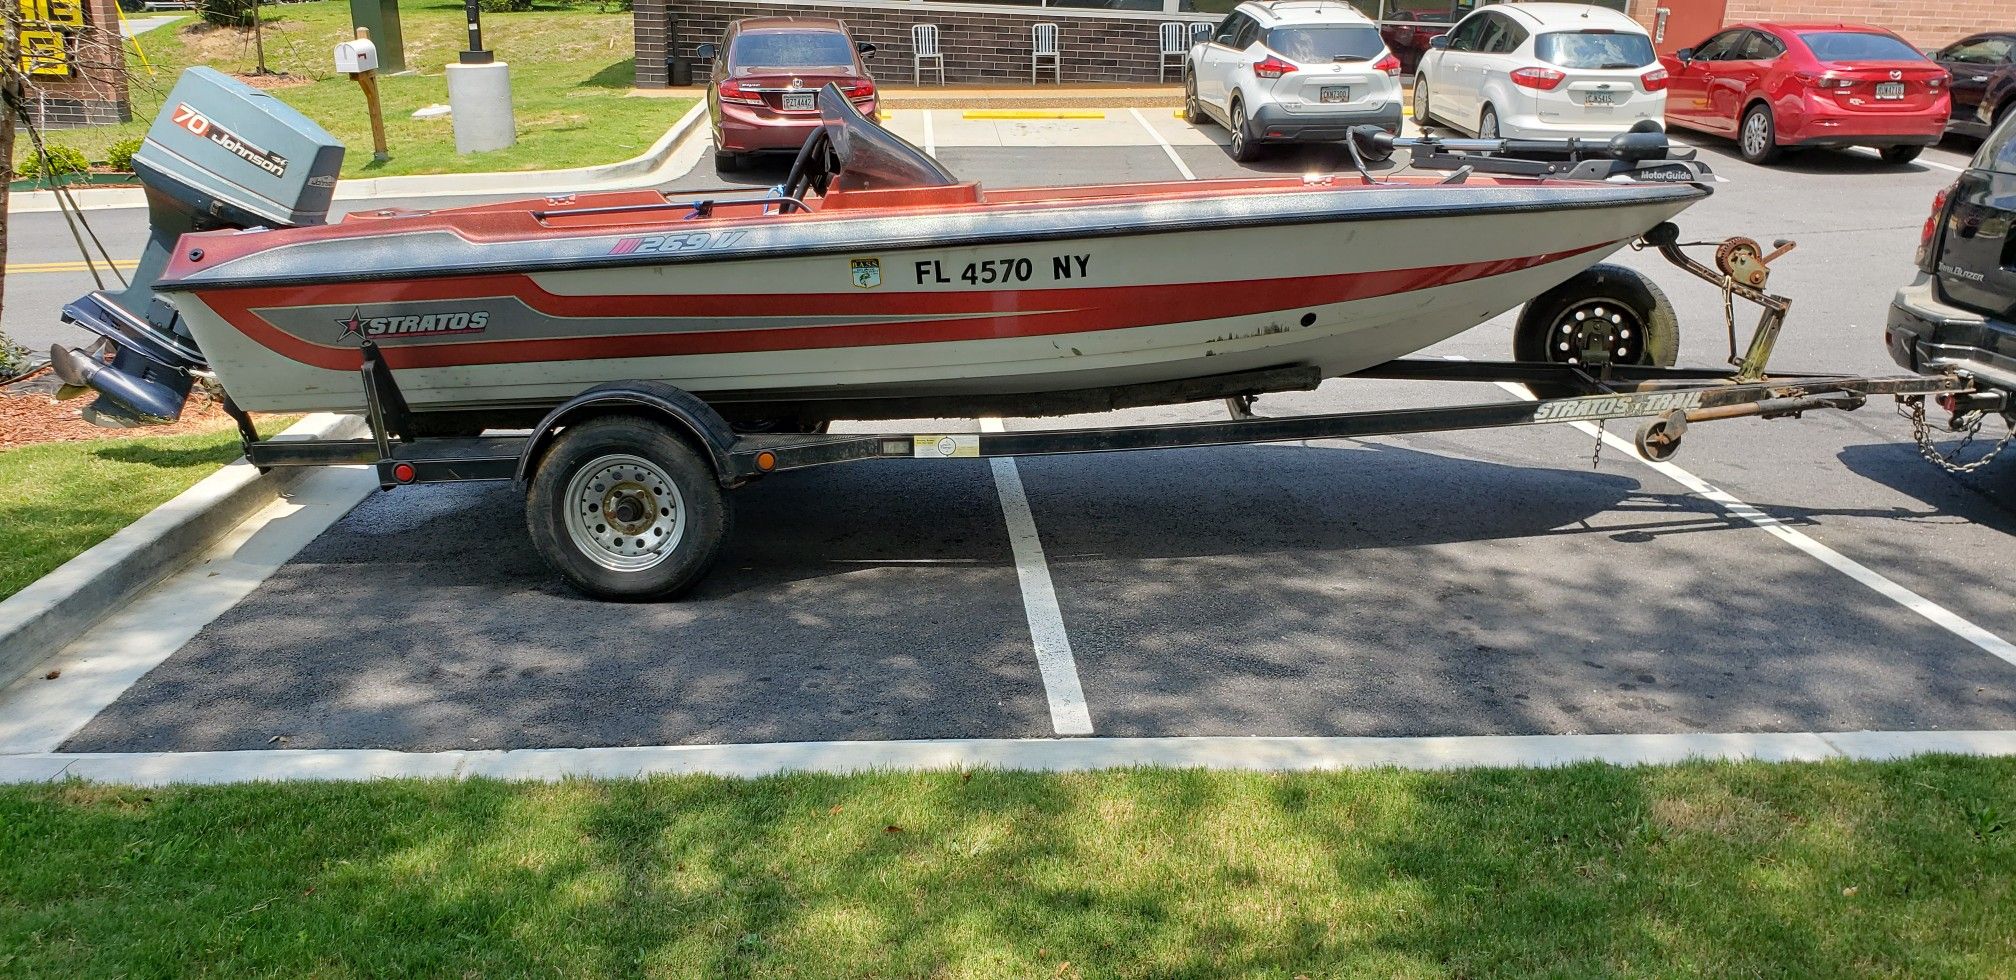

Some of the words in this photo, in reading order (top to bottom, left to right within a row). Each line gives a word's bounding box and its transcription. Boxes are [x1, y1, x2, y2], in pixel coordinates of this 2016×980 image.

[174, 104, 209, 134] 70
[212, 133, 284, 177] Johnson
[1641, 171, 1691, 180] MotorGuide
[635, 232, 711, 253] 269
[711, 231, 748, 249] V
[915, 260, 950, 284] FL
[961, 257, 1033, 285] 4570
[1053, 253, 1091, 280] NY
[367, 311, 490, 335] STRATOS
[1533, 397, 1631, 420] STRATOS
[1643, 391, 1701, 411] TRAIL
